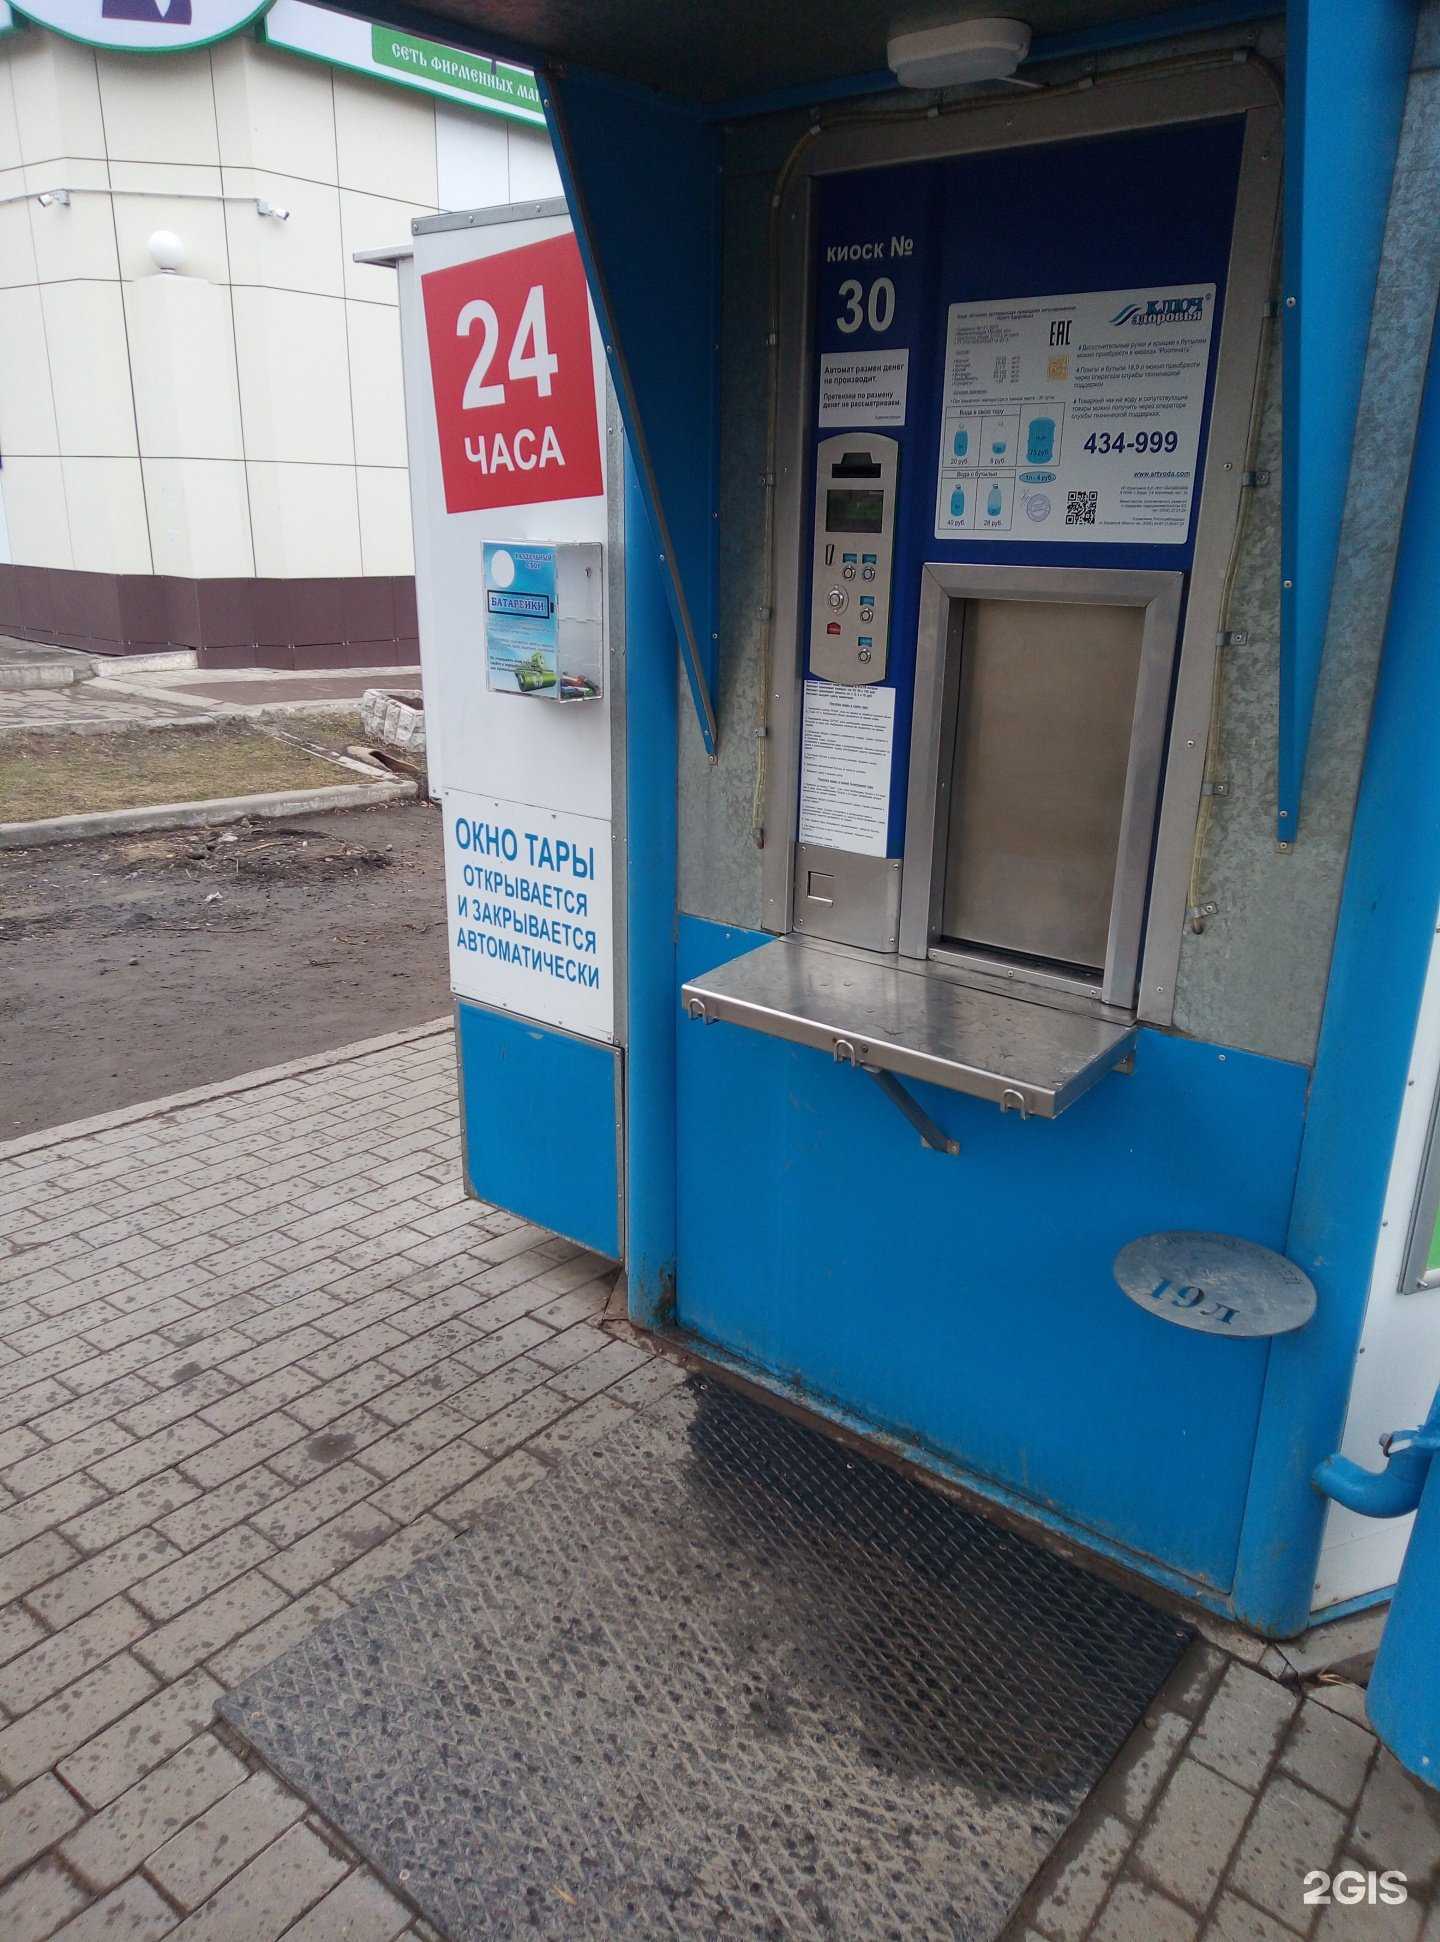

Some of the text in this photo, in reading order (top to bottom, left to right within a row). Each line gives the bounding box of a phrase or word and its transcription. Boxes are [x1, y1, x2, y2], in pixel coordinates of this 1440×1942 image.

[392, 43, 427, 67] СЕТЬ
[431, 56, 514, 94] ФИРМЕННЫХ
[890, 235, 914, 257] №
[836, 277, 896, 333] 30
[456, 285, 559, 410] 24
[825, 366, 854, 374] Автомат
[883, 364, 905, 373] денег
[464, 426, 566, 474] ЧАСА
[1083, 431, 1178, 454] 434-999
[455, 817, 594, 881] ОКНО ТАРЫ
[463, 864, 588, 917] ОТКРЫВАЕТСЯ
[458, 894, 597, 954] И ЗАКРЫВАЕТСЯ
[457, 927, 600, 990] АВТОМАТИЧЕСКИ
